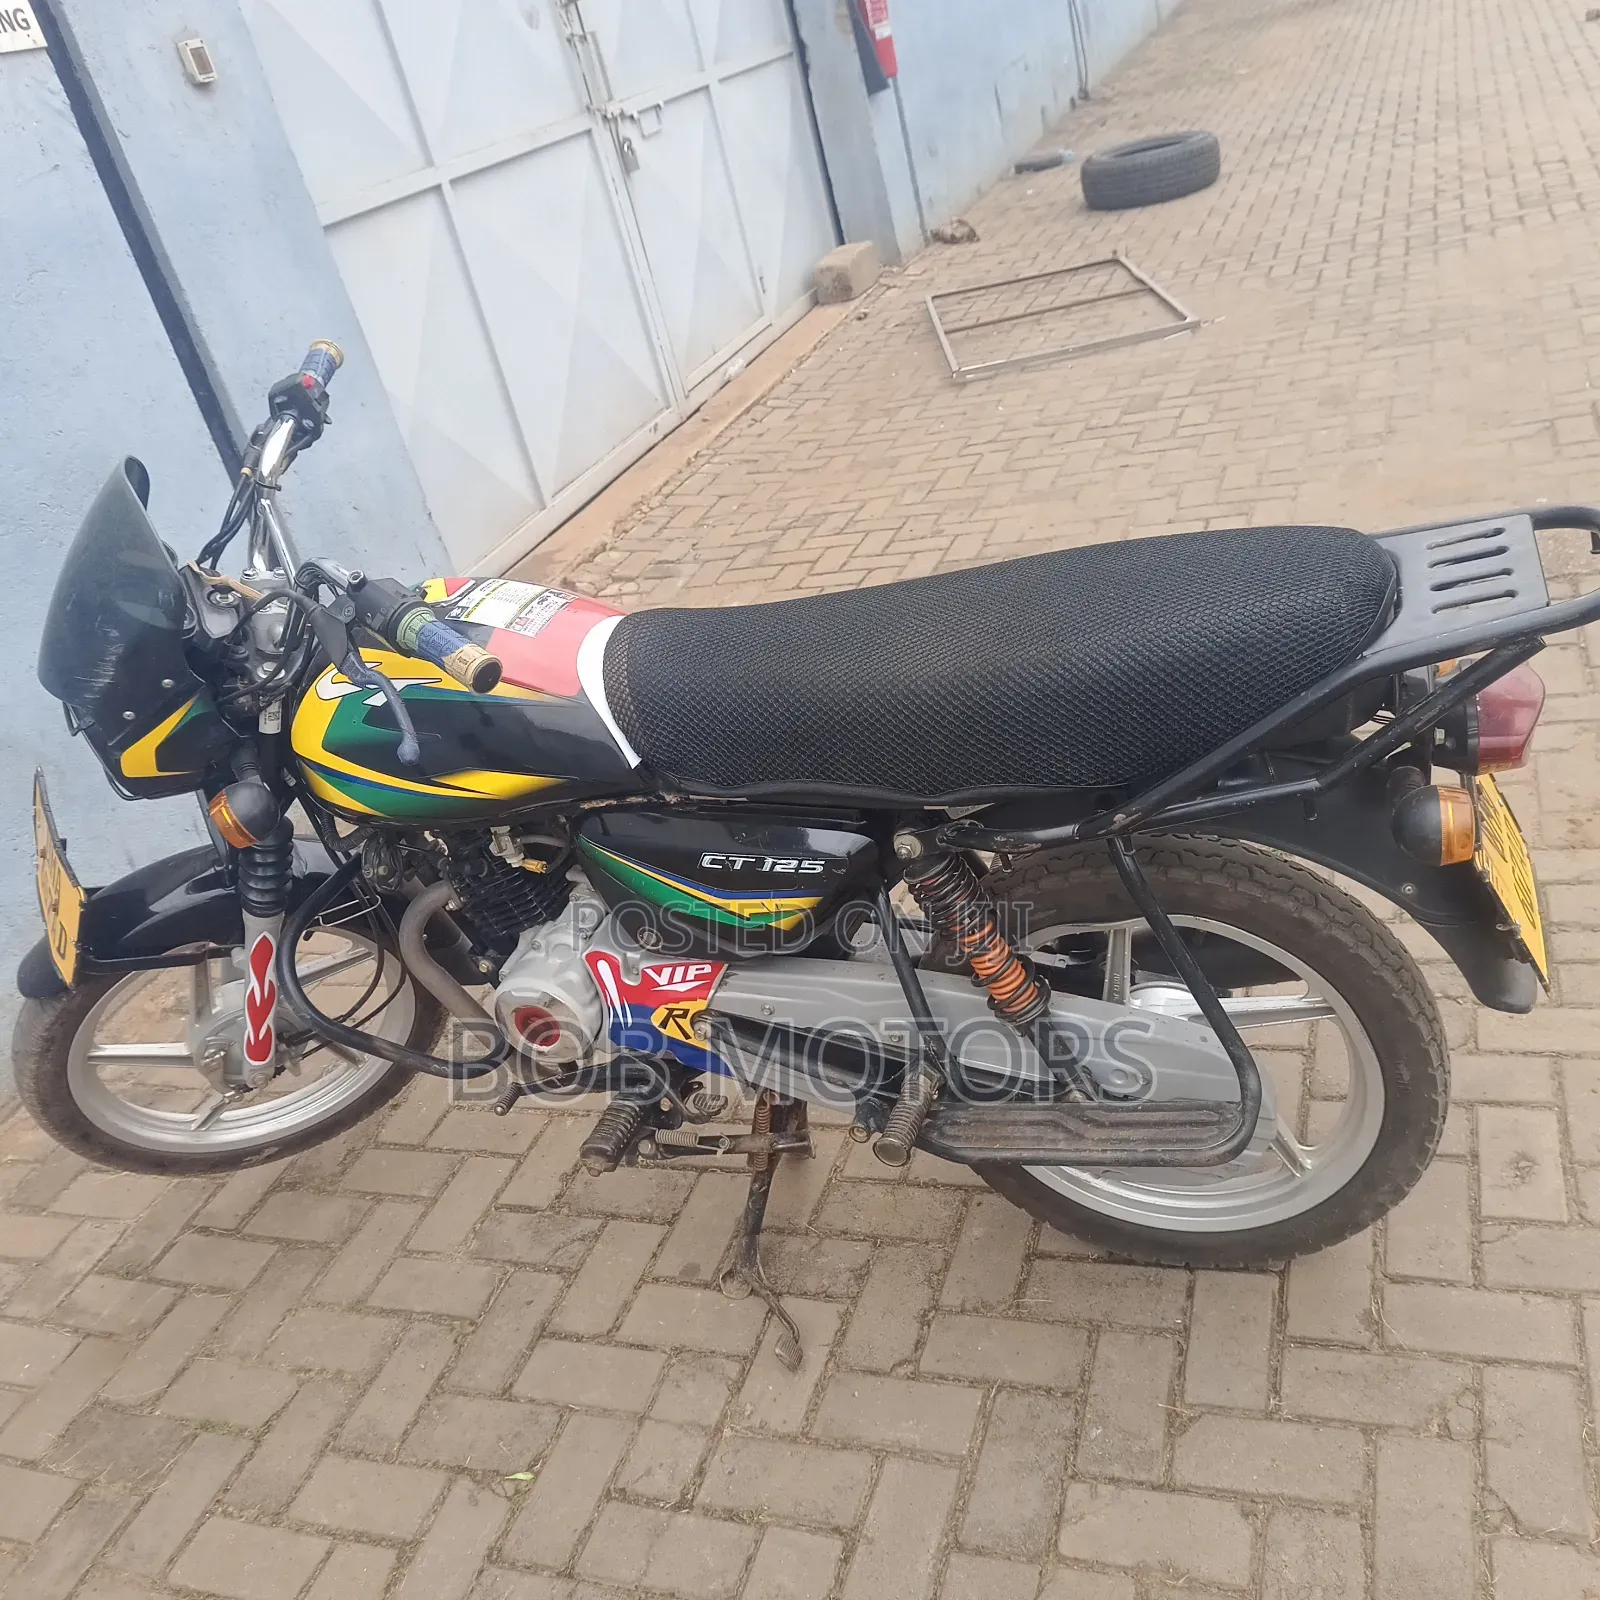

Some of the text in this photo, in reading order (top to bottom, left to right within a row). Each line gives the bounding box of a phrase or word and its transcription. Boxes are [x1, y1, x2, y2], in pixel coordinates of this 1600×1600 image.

[0, 7, 31, 34] NG
[701, 855, 826, 874] CT 125
[644, 963, 713, 986] VIP
